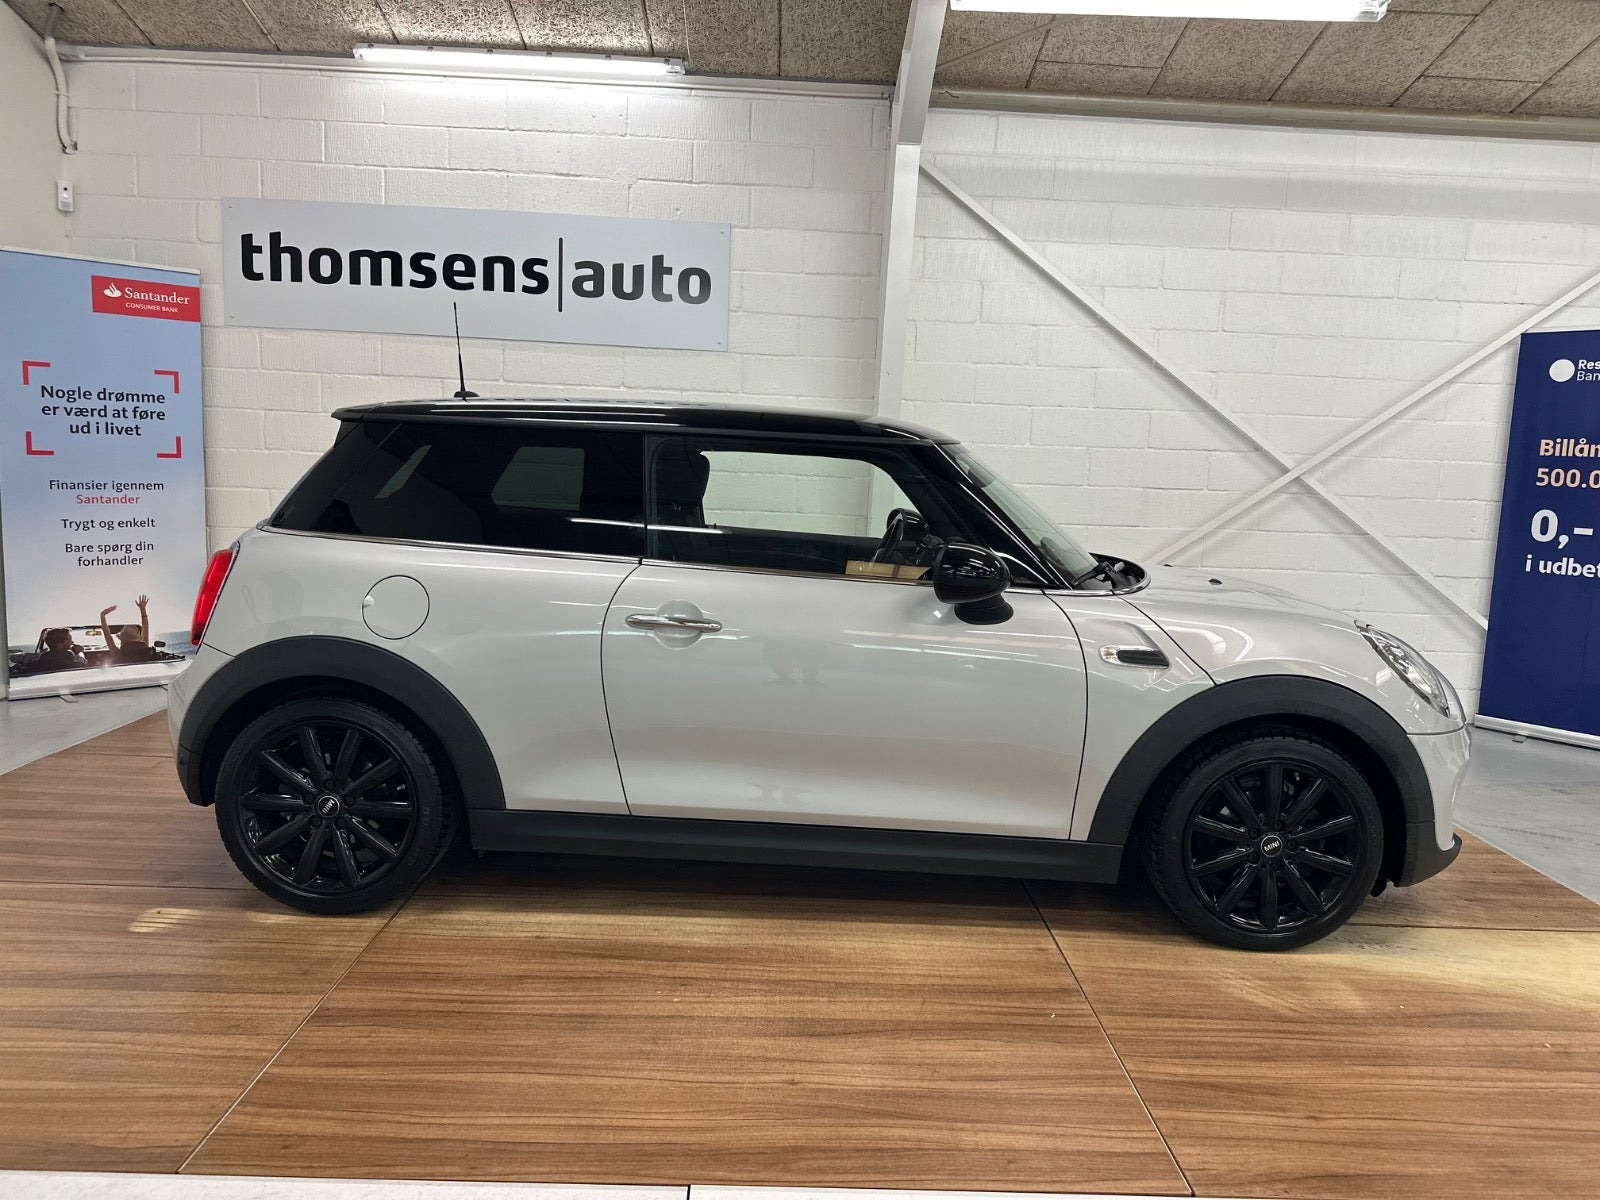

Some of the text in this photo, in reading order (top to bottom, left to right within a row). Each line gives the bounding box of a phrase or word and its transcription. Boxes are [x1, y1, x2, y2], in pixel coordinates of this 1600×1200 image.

[240, 230, 712, 305] thomsens auto
[124, 287, 190, 305] Santander
[126, 302, 160, 311] CONSUMER
[1578, 359, 1600, 370] Res
[1577, 371, 1600, 381] Ban
[41, 385, 166, 404] Nogle drømme
[41, 405, 166, 421] er værd at føre
[69, 421, 142, 436] ud i livet
[1539, 438, 1600, 458] Billån
[1536, 467, 1600, 489] 500.0
[49, 480, 164, 492] Finansier igennem
[76, 494, 140, 504] Santander
[61, 517, 156, 531] Trygt og enkelt
[65, 541, 154, 555] Bare spørg din
[77, 556, 144, 567] forhandler
[1525, 554, 1533, 572] i
[1264, 840, 1280, 852] MINI
